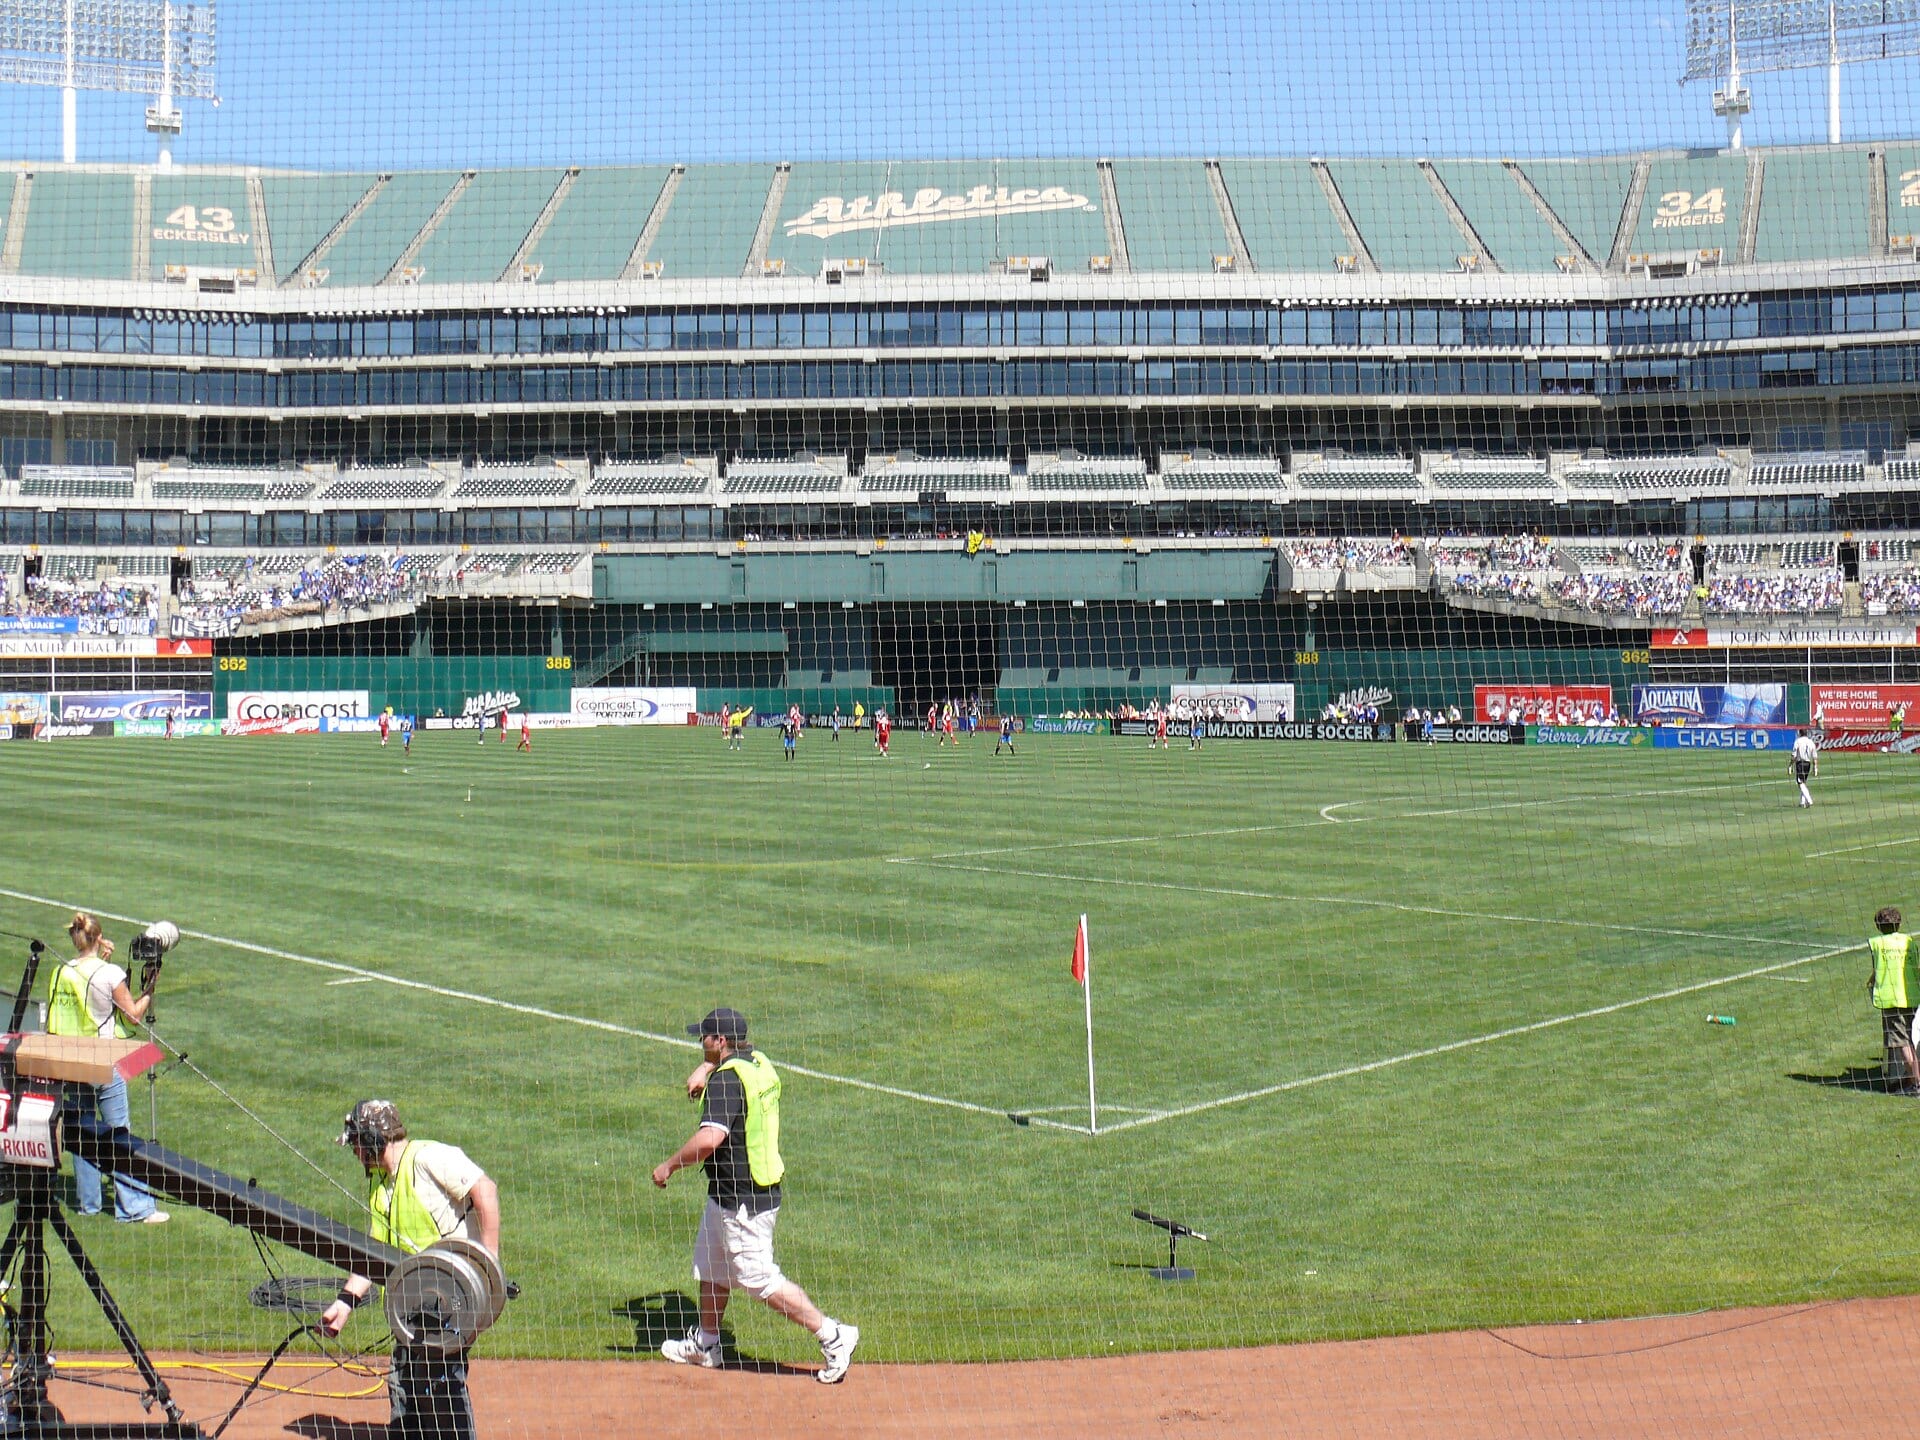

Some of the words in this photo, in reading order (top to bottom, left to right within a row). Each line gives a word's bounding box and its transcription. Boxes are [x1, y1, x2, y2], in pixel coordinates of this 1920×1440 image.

[783, 185, 1089, 237] Athletics
[1657, 188, 1726, 217] 34
[166, 204, 235, 232] 43
[1652, 213, 1725, 229] FINGERS
[153, 228, 250, 245] ECKERSLEY
[1730, 630, 1771, 644] JOHN
[1779, 630, 1821, 642] MUIR
[1828, 629, 1892, 642] HEALTH
[219, 657, 248, 671] 362
[546, 656, 572, 670] 388
[1294, 652, 1320, 665] 388
[1621, 651, 1649, 664] 362
[1336, 685, 1393, 711] Athletics
[1638, 687, 1704, 714] AQUAFINA
[1820, 691, 1848, 699] WE'RE
[1850, 690, 1878, 699] HOME
[64, 705, 121, 719] BUD
[132, 704, 209, 719] LIGHT
[247, 699, 360, 719] comcast
[462, 690, 520, 717] Athletics
[581, 700, 637, 711] comcast
[1509, 694, 1554, 716] State
[1849, 701, 1884, 710] YOU'RE
[538, 717, 572, 726] verizon
[1033, 719, 1063, 734] Sierra
[1063, 720, 1095, 735] Mist
[1147, 721, 1190, 737] adas
[1207, 722, 1255, 738] MAJOR
[1257, 723, 1313, 740] LEAGUE
[1316, 724, 1373, 741] SOCCER
[1455, 724, 1509, 743] adidas
[1536, 726, 1582, 744] Sierra
[1581, 726, 1630, 746] Mist
[1677, 730, 1747, 747] CHASE
[1810, 731, 1902, 751] Budweiser
[3, 1138, 48, 1159] RKING
